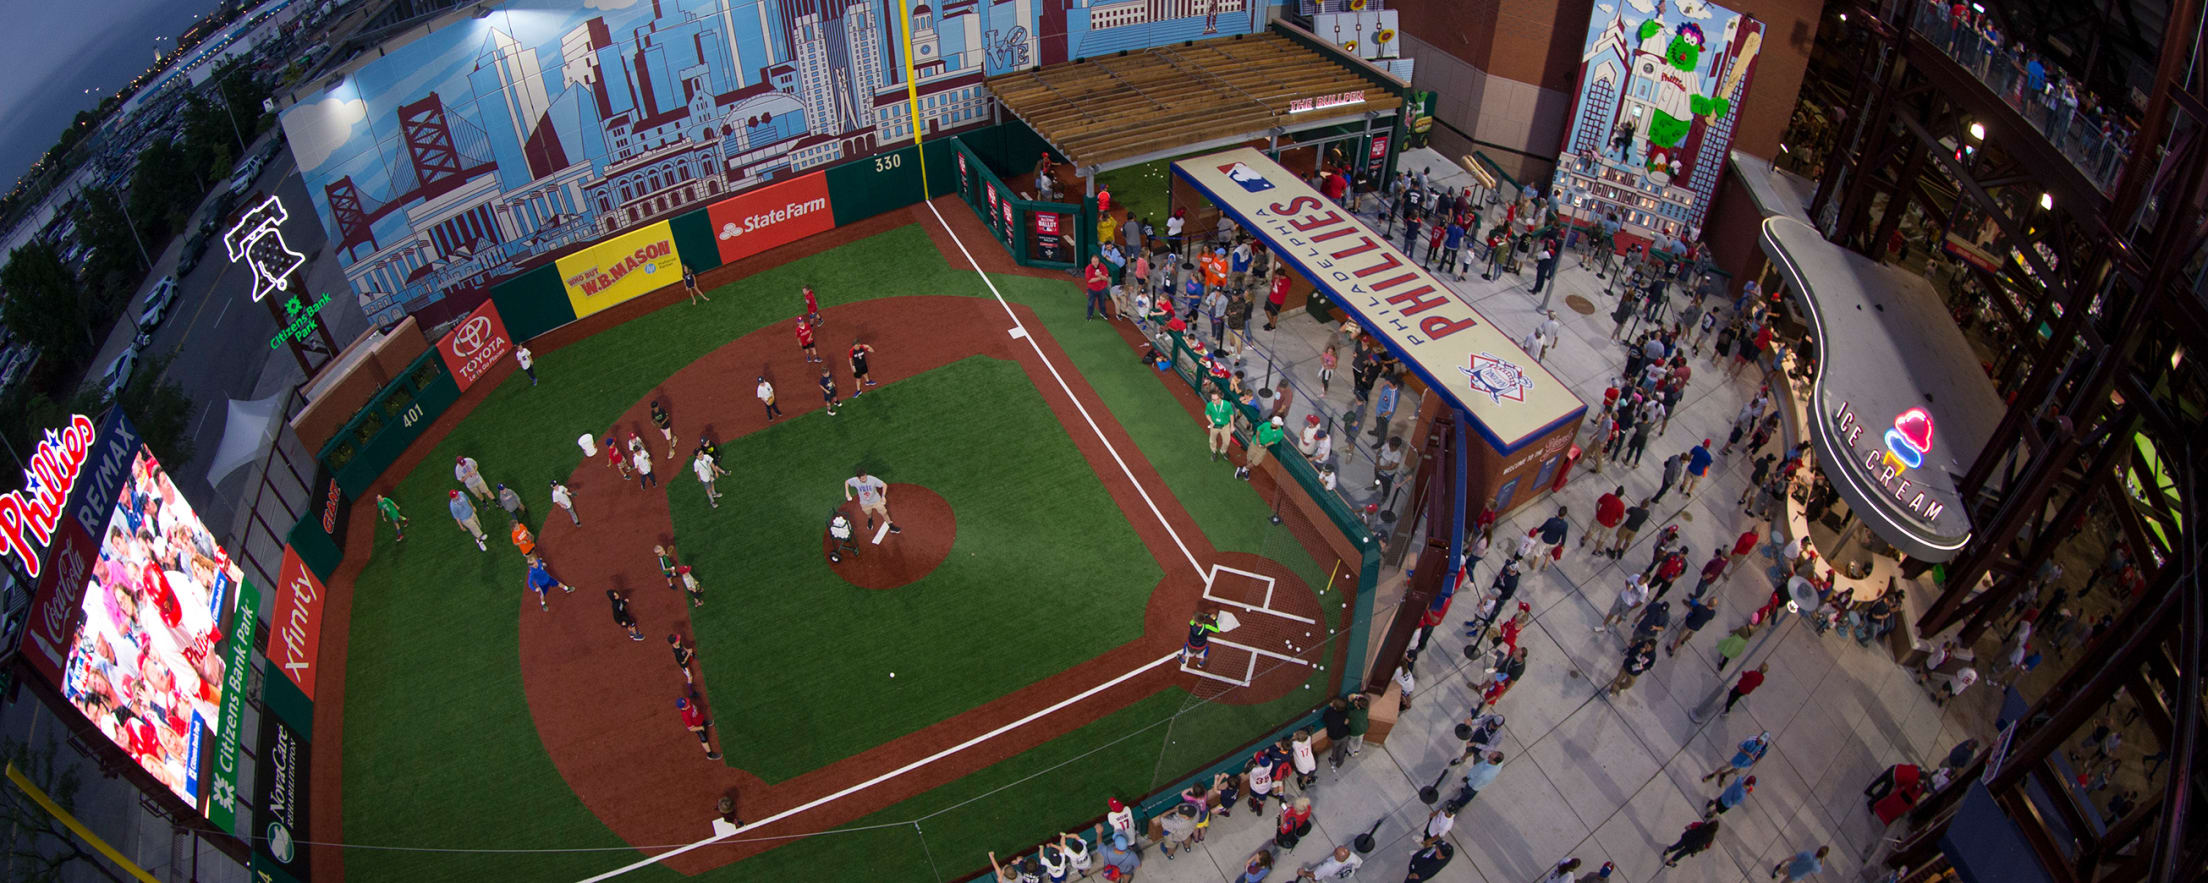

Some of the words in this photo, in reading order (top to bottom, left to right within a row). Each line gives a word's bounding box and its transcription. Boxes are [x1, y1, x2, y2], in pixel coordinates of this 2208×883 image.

[1290, 97, 1313, 111] THE
[1316, 90, 1366, 107] BULLPEN
[875, 154, 901, 172] 330
[567, 274, 584, 288] WHO
[584, 265, 600, 280] BUT
[1256, 208, 1425, 346] PHILADELPHIA
[1269, 196, 1478, 341] PHILLIES
[270, 315, 309, 350] Citizens
[306, 292, 332, 319] Bank
[294, 319, 318, 343] Park
[459, 336, 505, 378] TOYOTA
[402, 403, 424, 429] 401
[77, 415, 135, 537] RE/MAX
[1836, 401, 1863, 448] ICE
[1865, 449, 1944, 521] CREAM
[0, 413, 96, 578] Phillies
[323, 478, 341, 534] GIANT
[236, 604, 254, 646] Park
[284, 562, 318, 683] xfinity
[228, 643, 247, 694] Bank
[219, 692, 240, 773] Citizens
[269, 724, 288, 824] NovaCare
[287, 737, 297, 830] REHABILITATION
